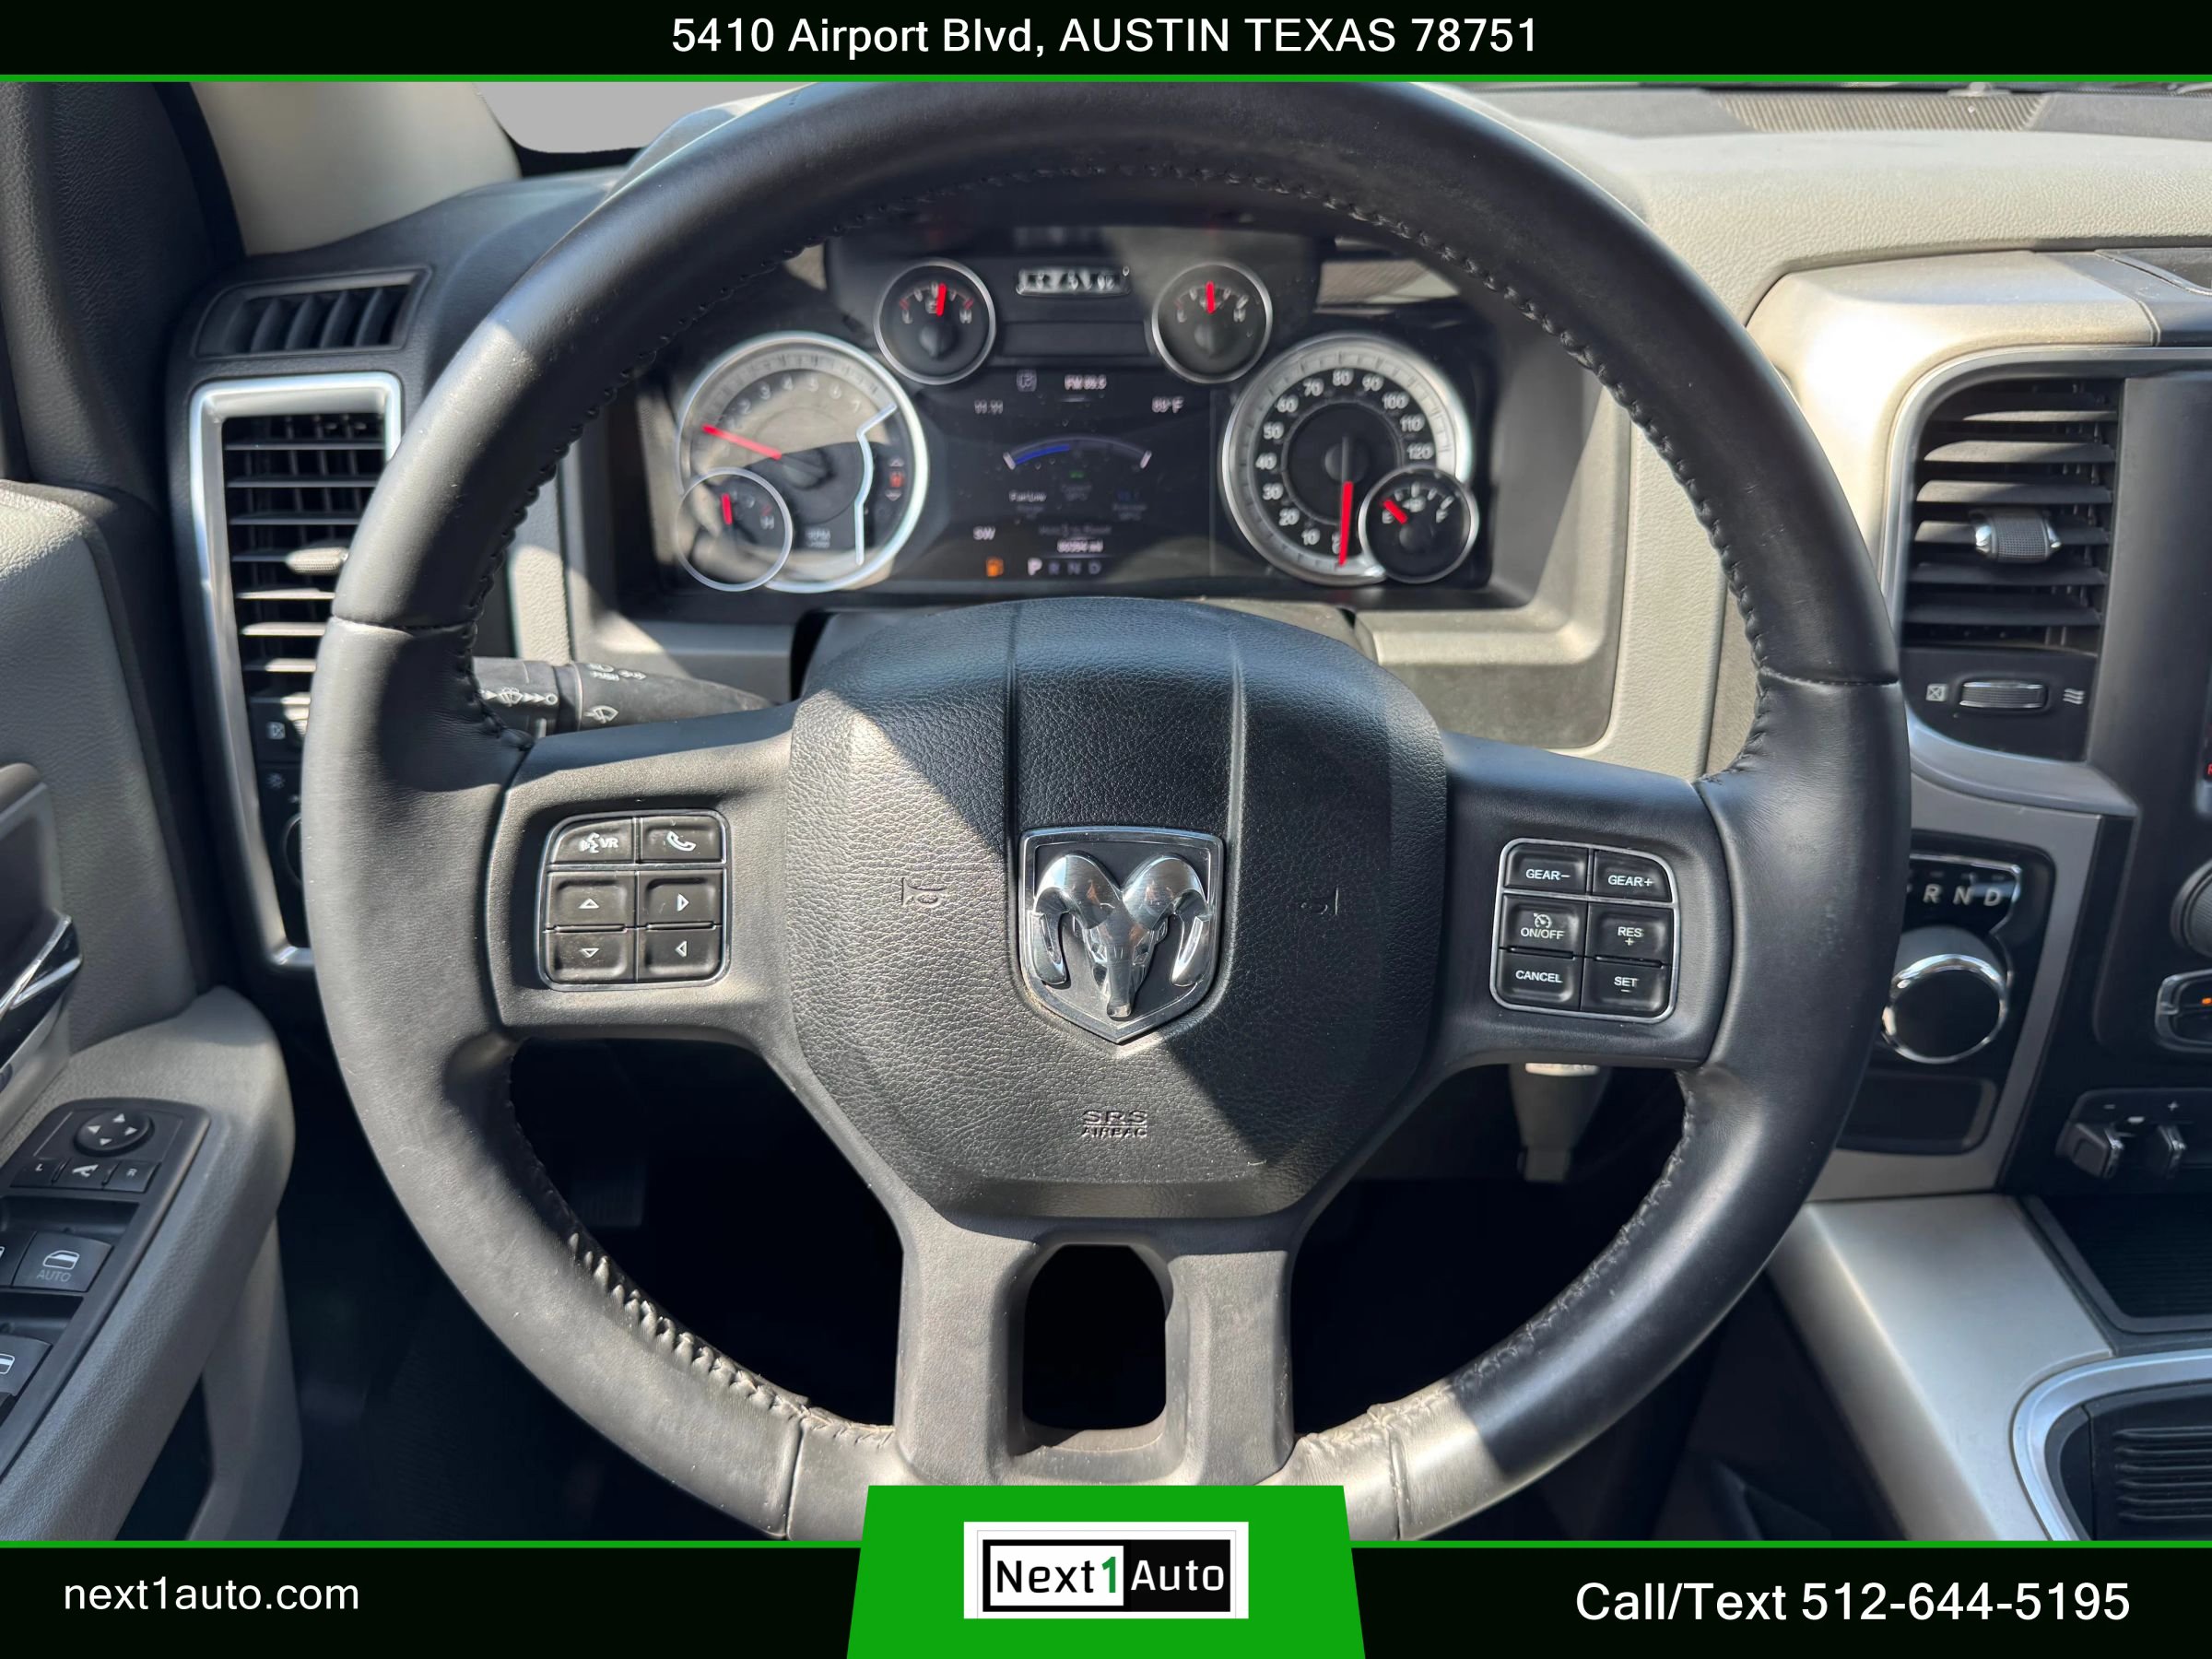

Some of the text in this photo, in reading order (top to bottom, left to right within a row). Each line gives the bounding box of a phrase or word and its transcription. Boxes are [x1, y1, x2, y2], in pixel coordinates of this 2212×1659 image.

[1333, 369, 1354, 386] 80
[1362, 373, 1383, 392] 90
[1302, 378, 1324, 396] 70
[1276, 394, 1300, 413] 60
[1382, 392, 1409, 409] 100
[1263, 421, 1284, 441] 50
[1400, 415, 1425, 432] 110
[1407, 442, 1434, 461] 120
[1255, 452, 1277, 470] 40
[1262, 483, 1284, 500] 30
[1278, 508, 1300, 526] 20
[1301, 528, 1321, 546] 10
[1028, 558, 1042, 575] P
[600, 838, 619, 849] VR
[1923, 884, 1941, 904] R
[1953, 886, 1973, 905] N
[1983, 887, 2003, 907] D
[1521, 927, 1565, 940] ON/OFF
[1618, 926, 1643, 937] RES
[1515, 970, 1563, 983] CANCEL
[1614, 976, 1639, 987] SET
[1081, 1110, 1148, 1125] SRS
[126, 1168, 137, 1177] R
[36, 1269, 72, 1282] AUTO
